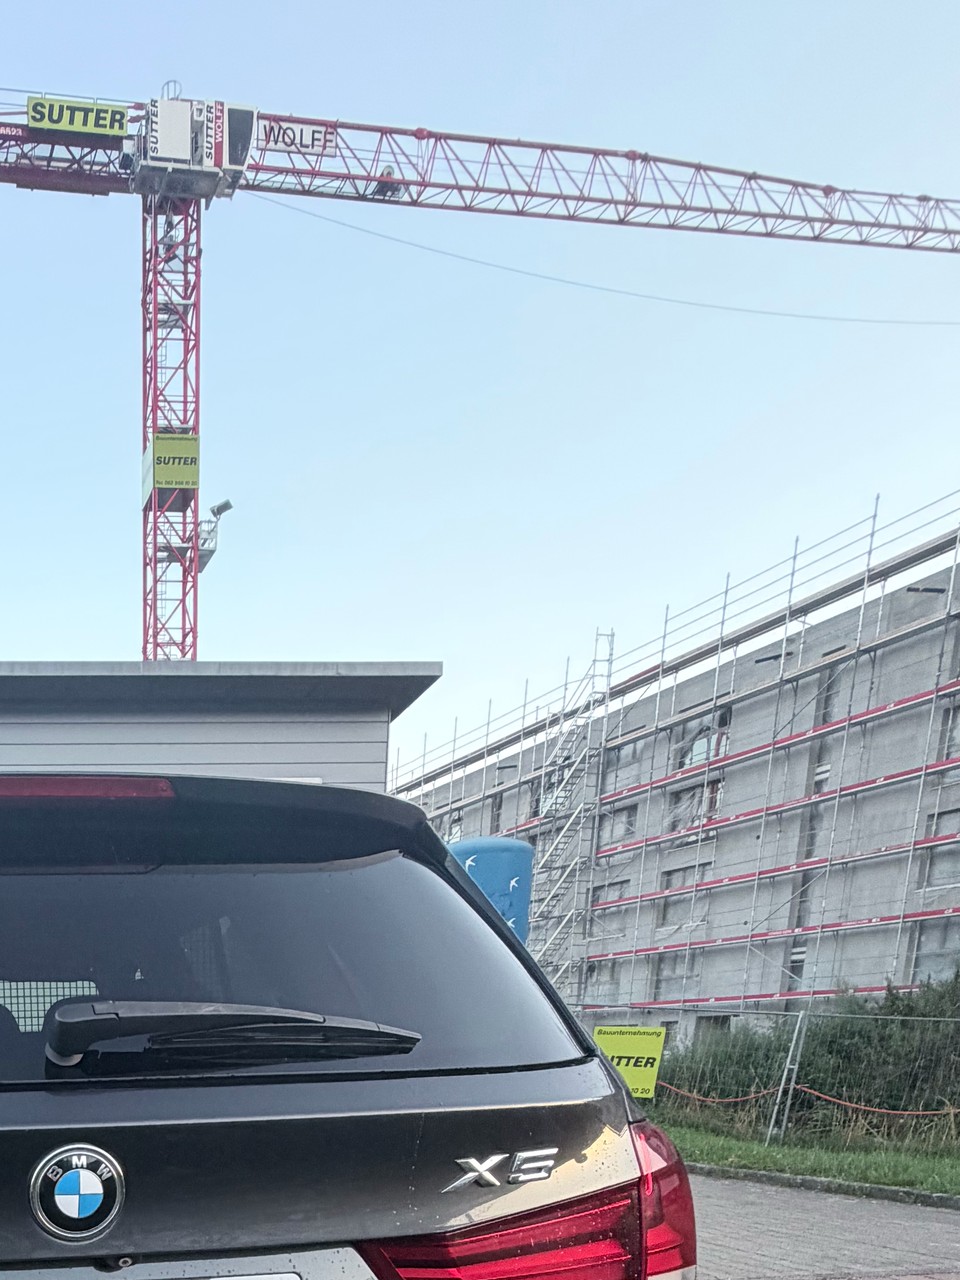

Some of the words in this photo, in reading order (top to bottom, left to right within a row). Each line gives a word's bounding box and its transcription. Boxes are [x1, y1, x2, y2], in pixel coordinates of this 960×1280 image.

[31, 101, 127, 131] SUTTER
[150, 98, 159, 155] SUTTER
[215, 101, 225, 143] WOLFF
[205, 104, 215, 160] SUTTER
[263, 123, 336, 151] WOLFF
[155, 456, 198, 466] SUTTER
[597, 1028, 662, 1038] Bauunternehmung
[610, 1055, 657, 1068] TTER
[46, 1154, 113, 1182] BMW
[440, 1147, 559, 1194] X5
